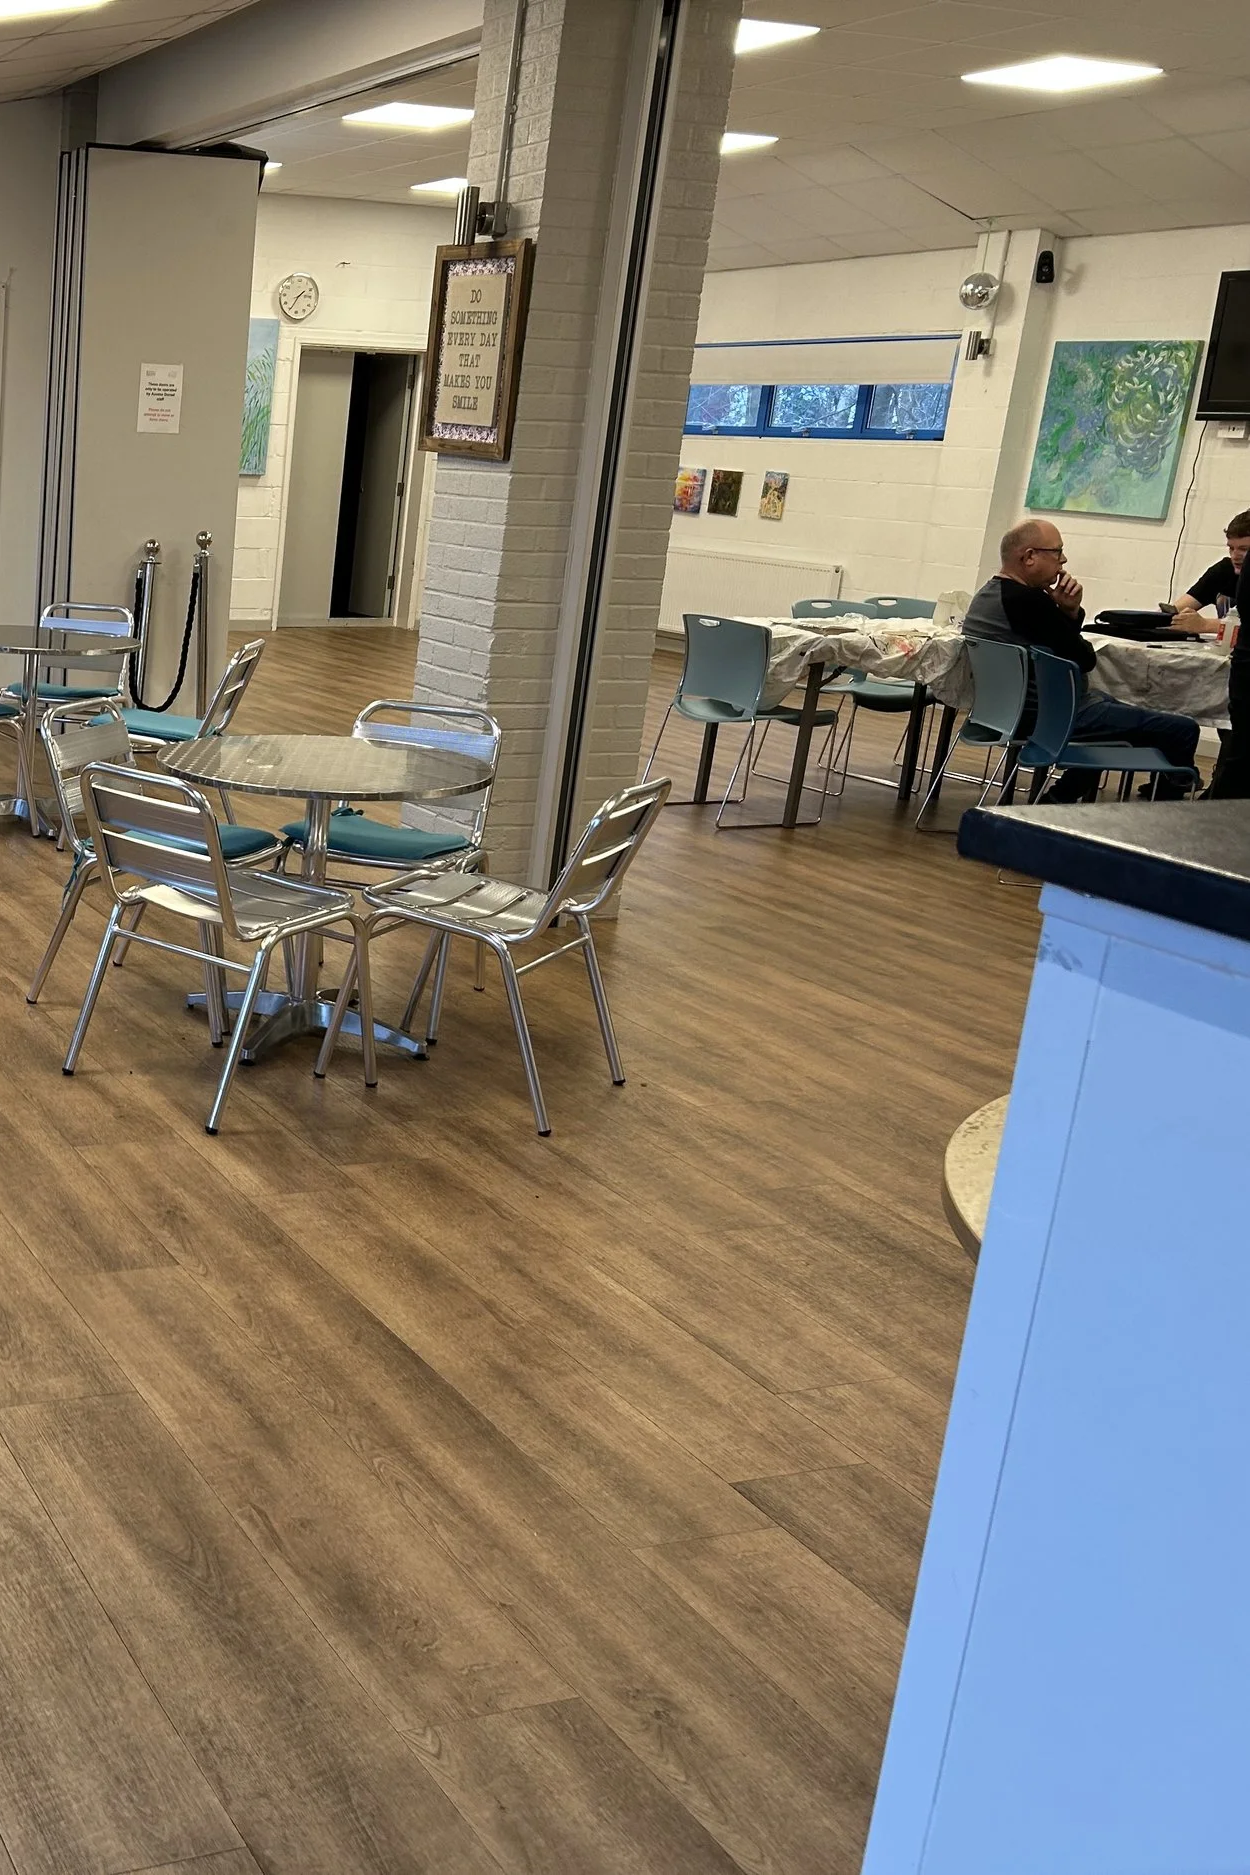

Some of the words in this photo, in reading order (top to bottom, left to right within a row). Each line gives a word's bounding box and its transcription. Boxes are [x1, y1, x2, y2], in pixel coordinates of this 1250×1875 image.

[470, 289, 482, 303] DO
[450, 311, 498, 325] SOMETHING
[447, 332, 476, 346] EVERY
[479, 332, 498, 347] DAY
[459, 353, 481, 368] THAT
[443, 374, 470, 388] MAKES
[475, 375, 493, 390] YOU
[452, 395, 478, 411] SMILE
